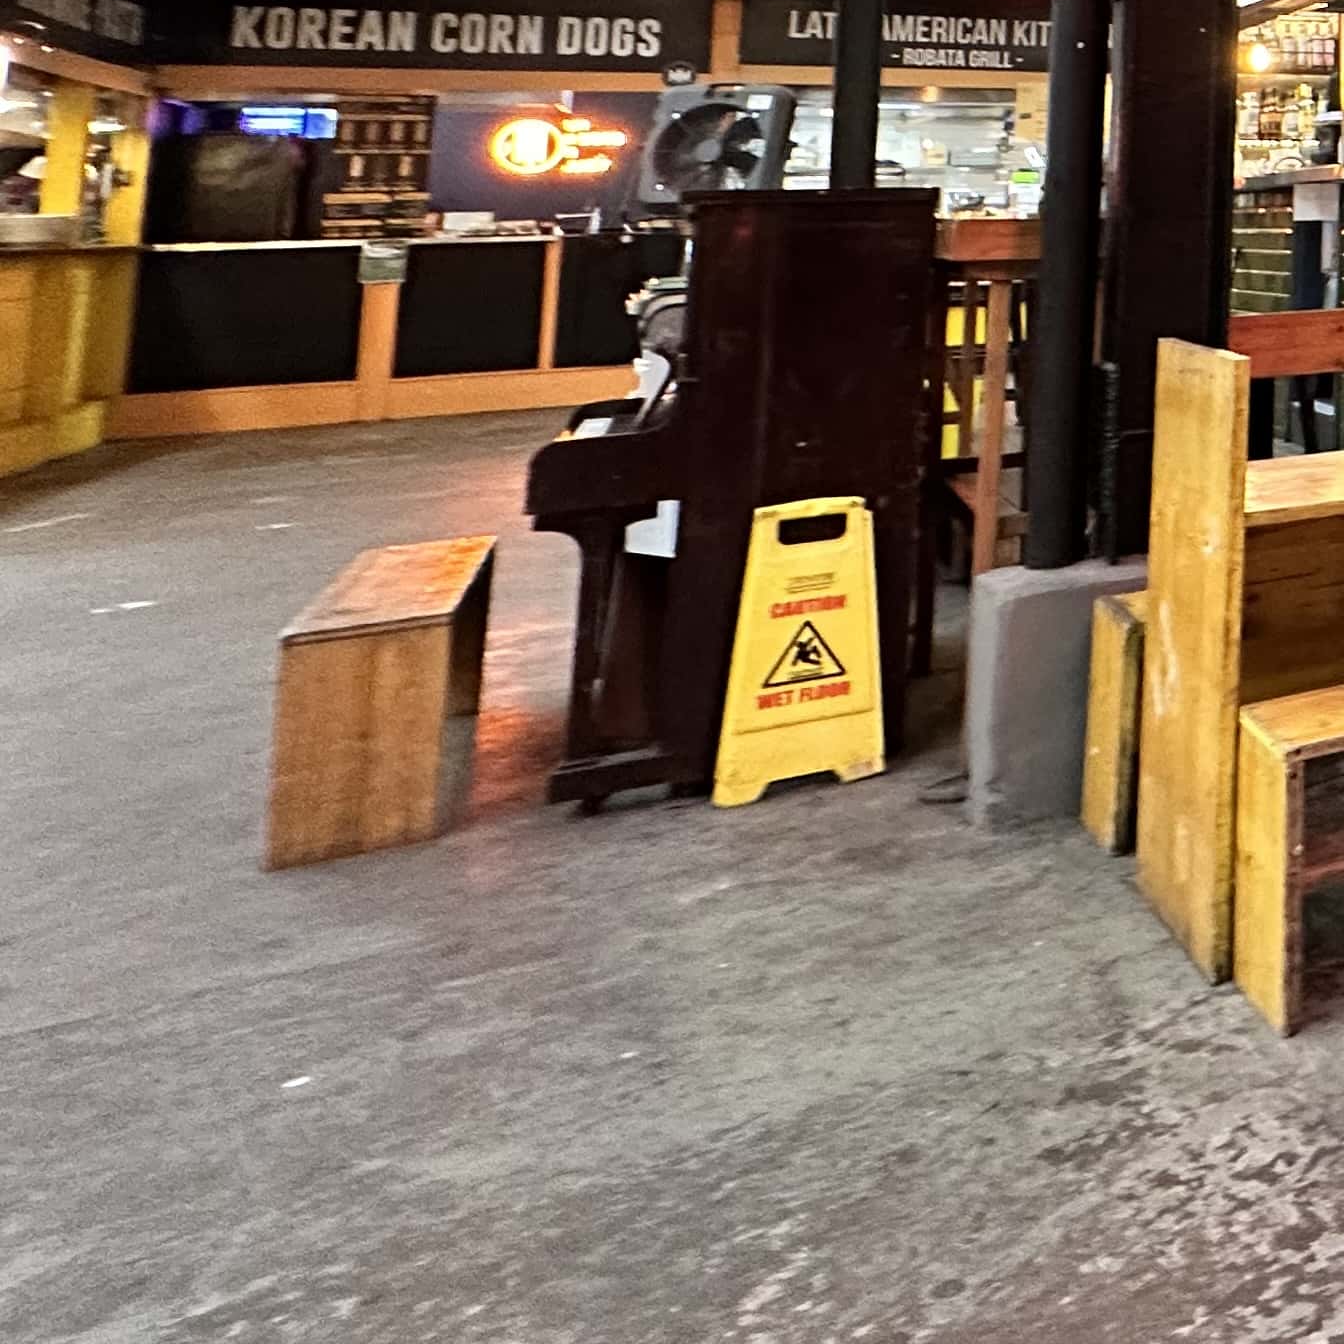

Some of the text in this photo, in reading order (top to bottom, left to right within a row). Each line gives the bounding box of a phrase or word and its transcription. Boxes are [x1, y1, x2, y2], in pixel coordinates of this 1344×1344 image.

[231, 6, 662, 57] KOREAN CORN DOGS
[789, 9, 834, 39] LAT
[903, 48, 1014, 69] ROBATA GRILL
[758, 681, 851, 710] WET FLOOR
